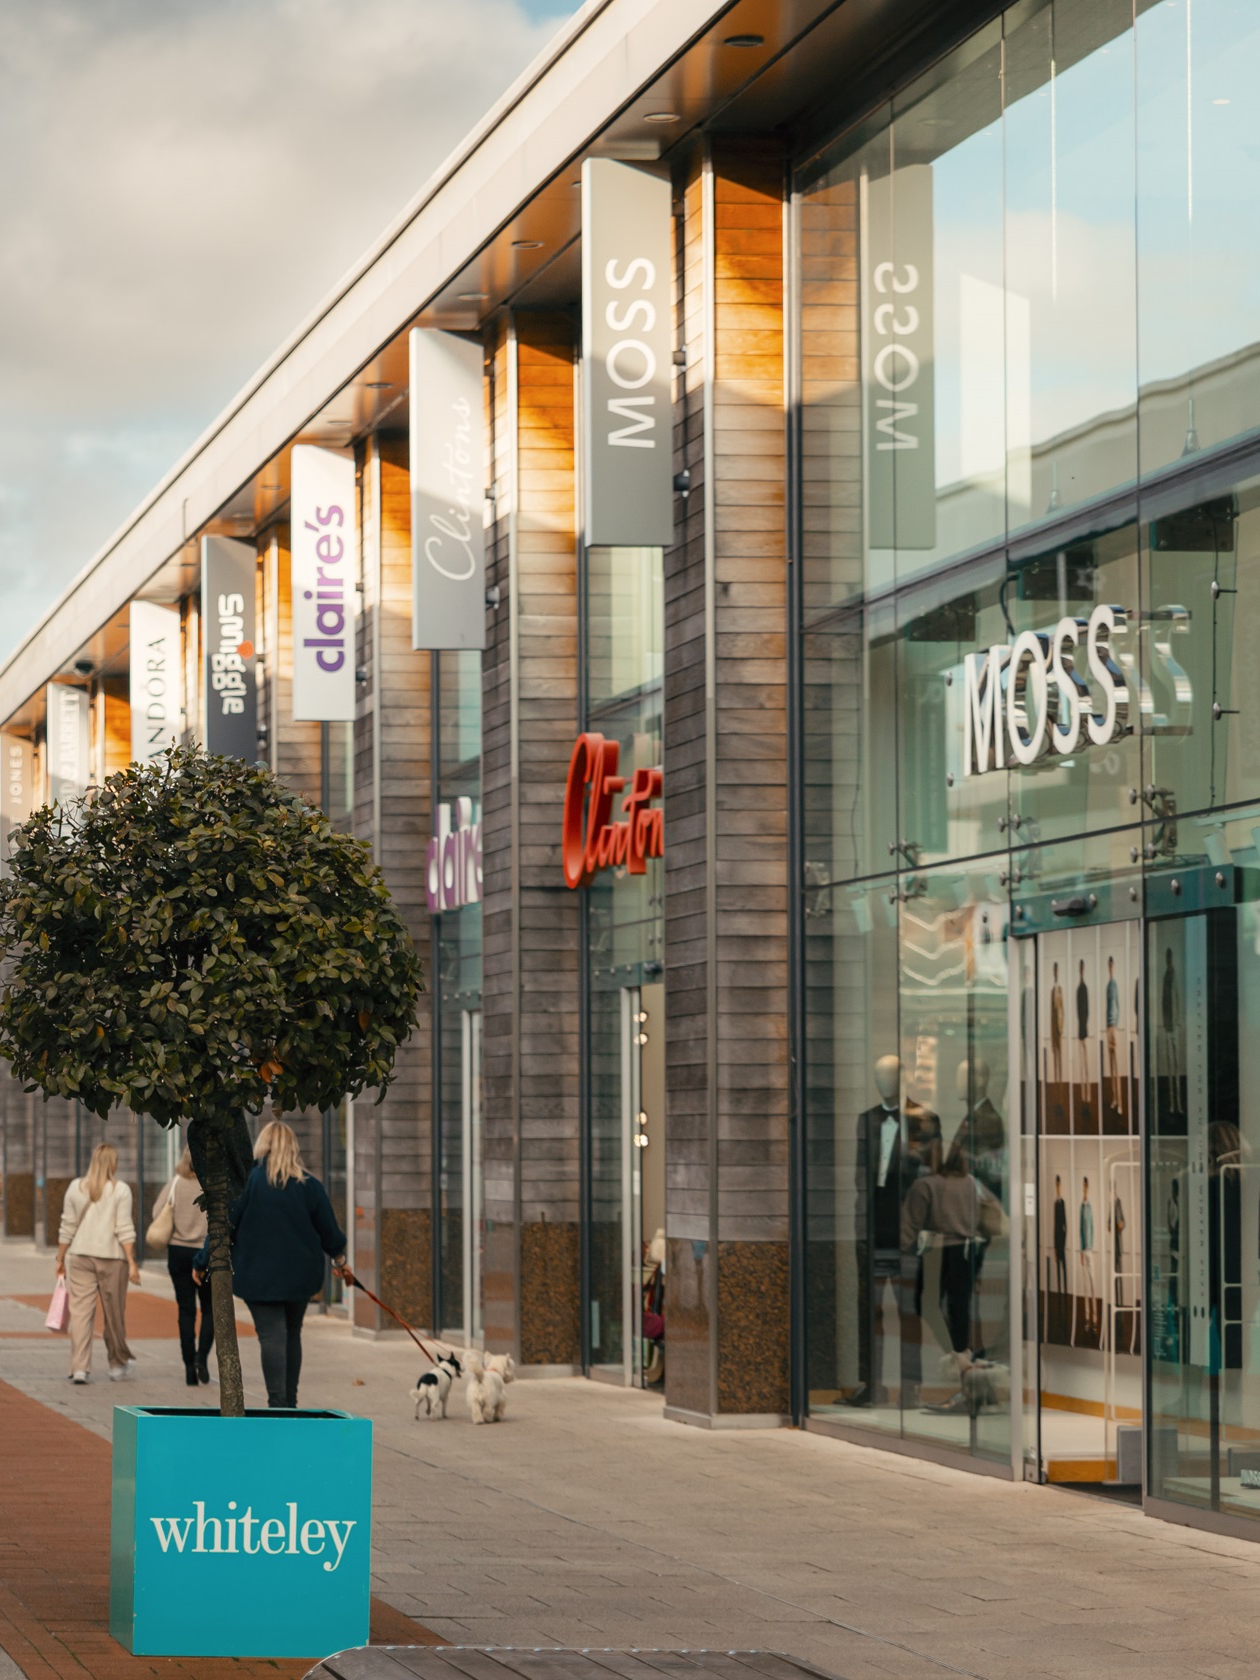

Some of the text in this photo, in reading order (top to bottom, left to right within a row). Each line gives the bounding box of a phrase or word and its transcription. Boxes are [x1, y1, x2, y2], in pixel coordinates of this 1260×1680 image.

[604, 256, 657, 449] MOSS
[425, 397, 476, 580] Clintons
[211, 593, 254, 715] smiggle
[303, 503, 345, 673] claire's
[147, 637, 167, 768] ANDORA
[964, 604, 1125, 776] MOSS
[9, 745, 23, 804] JONES
[562, 732, 665, 889] Clinton
[149, 1500, 357, 1572] whiteley
